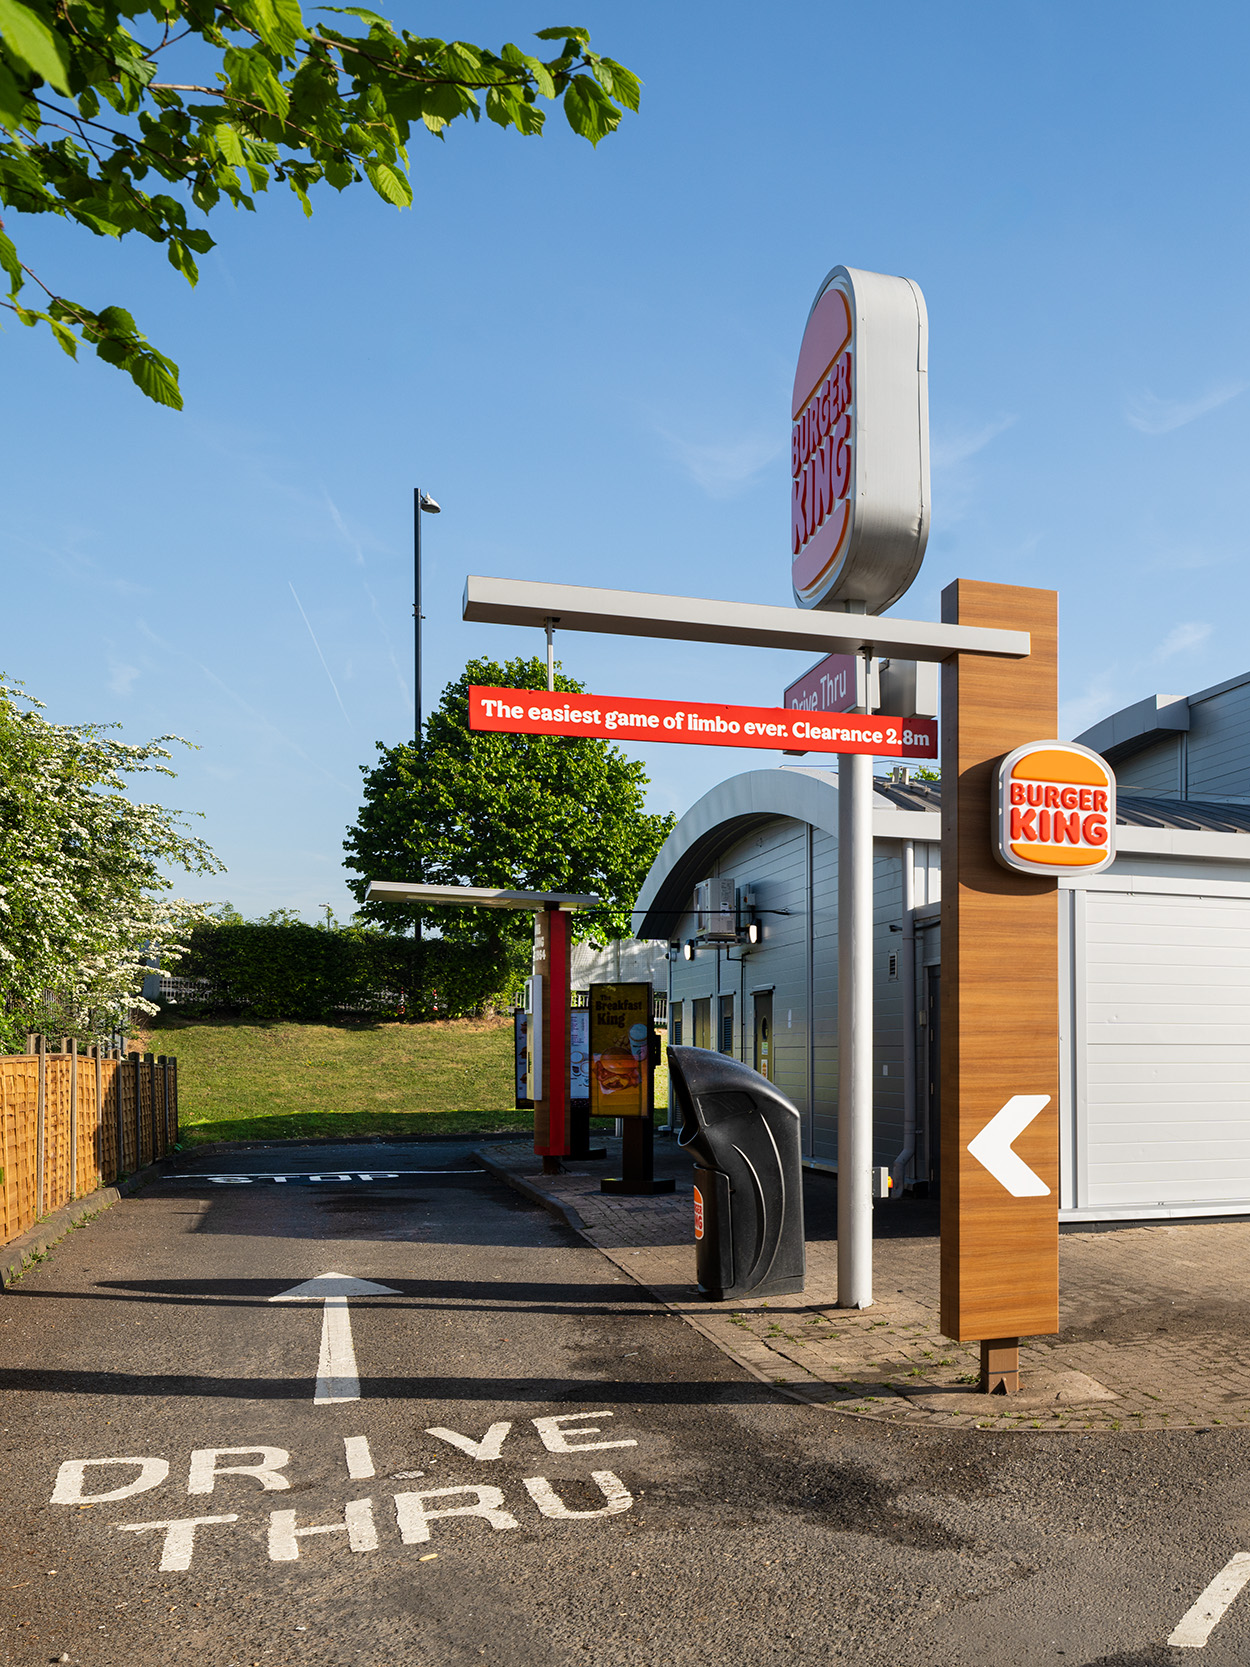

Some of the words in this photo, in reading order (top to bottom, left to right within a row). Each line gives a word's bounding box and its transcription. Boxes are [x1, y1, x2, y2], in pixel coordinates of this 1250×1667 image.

[791, 351, 852, 479] BURGER
[791, 413, 852, 555] KING
[819, 669, 847, 710] Thru
[481, 699, 524, 719] The
[528, 705, 602, 725] easiest
[604, 711, 660, 730] game
[663, 711, 686, 729] of
[687, 714, 741, 734] limbo
[744, 720, 789, 738] ever.
[792, 721, 883, 744] Clearance
[886, 728, 930, 747] 2.8m
[1010, 782, 1109, 813] BURGER
[1010, 807, 1109, 846] KING
[595, 999, 643, 1011] Breakfast
[597, 1011, 626, 1028] King
[207, 1173, 399, 1184] STOP
[49, 1410, 639, 1505] DRIVE
[117, 1470, 635, 1572] THRU
